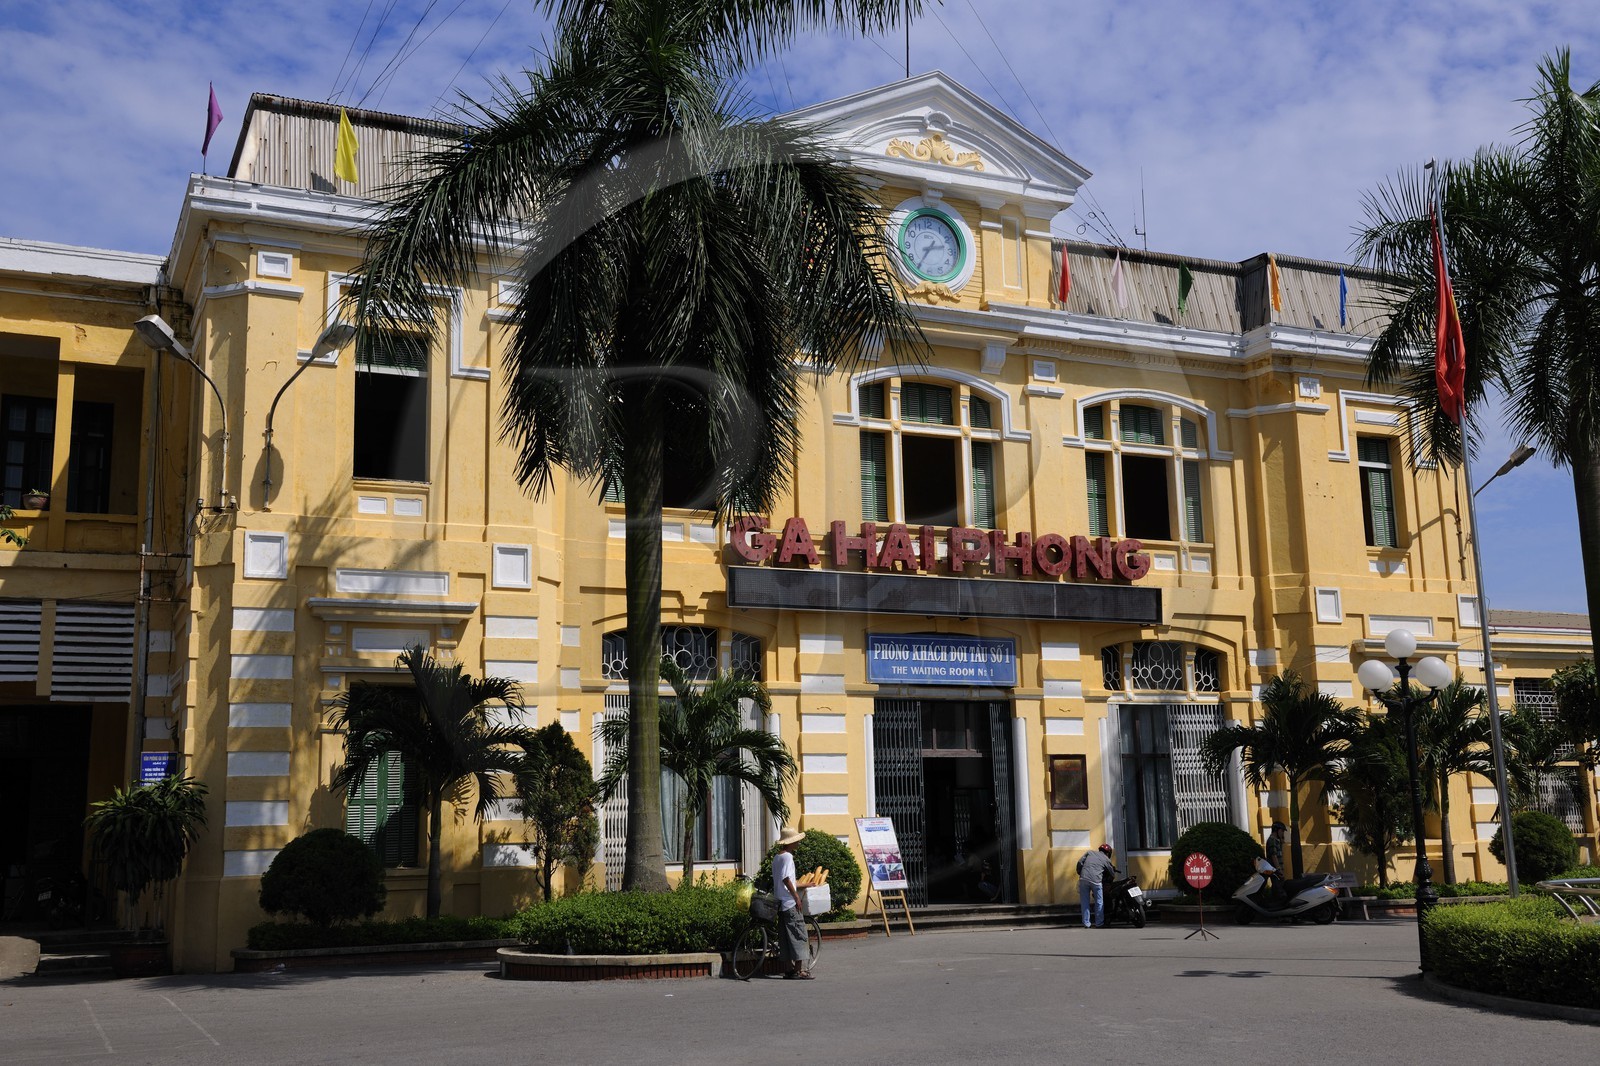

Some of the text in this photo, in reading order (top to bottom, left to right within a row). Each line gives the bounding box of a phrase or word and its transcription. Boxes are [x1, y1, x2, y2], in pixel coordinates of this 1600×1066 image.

[924, 221, 932, 229] 12
[908, 230, 916, 238] 10
[945, 236, 950, 244] 2
[905, 241, 911, 249] 9
[948, 248, 953, 256] 3
[730, 516, 1150, 580] GA HAI PHONG
[873, 641, 909, 661] PHÒNG
[912, 642, 948, 662] KHÁCH
[970, 644, 988, 663] TÀU
[990, 644, 1004, 663] SỐ
[1005, 647, 1010, 664] 1
[892, 665, 908, 675] THE
[911, 666, 946, 676] WAITING
[950, 668, 974, 676] ROOM
[1186, 854, 1197, 867] KHU
